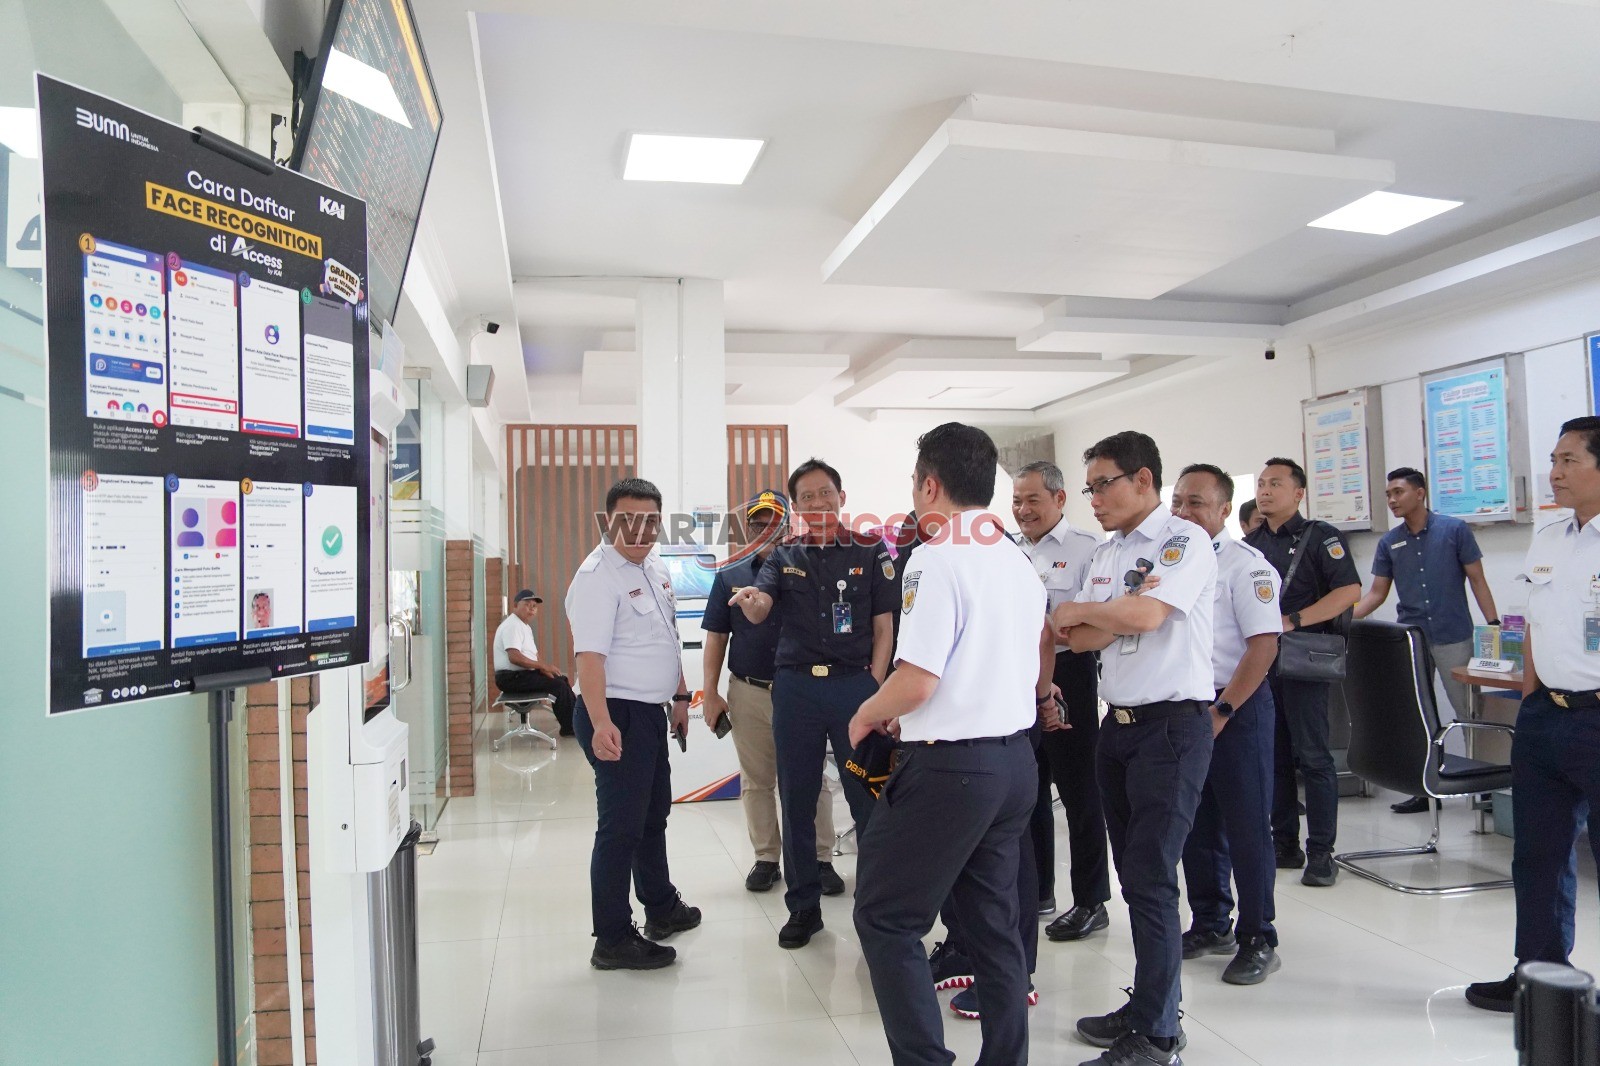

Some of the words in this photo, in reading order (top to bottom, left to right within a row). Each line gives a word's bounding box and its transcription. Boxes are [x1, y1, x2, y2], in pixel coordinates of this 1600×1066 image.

[76, 107, 130, 142] BUMN
[131, 132, 149, 143] UNTUK
[131, 138, 159, 152] INDONESIA
[187, 170, 235, 202] Cara
[240, 188, 295, 222] Daftar
[320, 195, 345, 220] KAI
[151, 188, 203, 220] FACE
[206, 204, 319, 256] RECOGNITION
[210, 234, 227, 254] di
[231, 236, 283, 270] Access
[267, 267, 273, 276] by
[273, 269, 283, 277] KAI
[330, 264, 358, 287] GRATIS!
[125, 425, 142, 433] Access
[1051, 561, 1067, 569] KAI
[848, 567, 864, 576] KAI
[242, 642, 261, 650] Pastikan
[269, 640, 280, 648] yang
[271, 644, 287, 652] "Daftar
[286, 641, 307, 650] Sekarang"
[210, 647, 228, 655] dengan
[117, 656, 141, 665] termasuk
[1479, 660, 1500, 668] FEBRIAN
[99, 665, 119, 674] tanggal
[87, 673, 101, 682] yang
